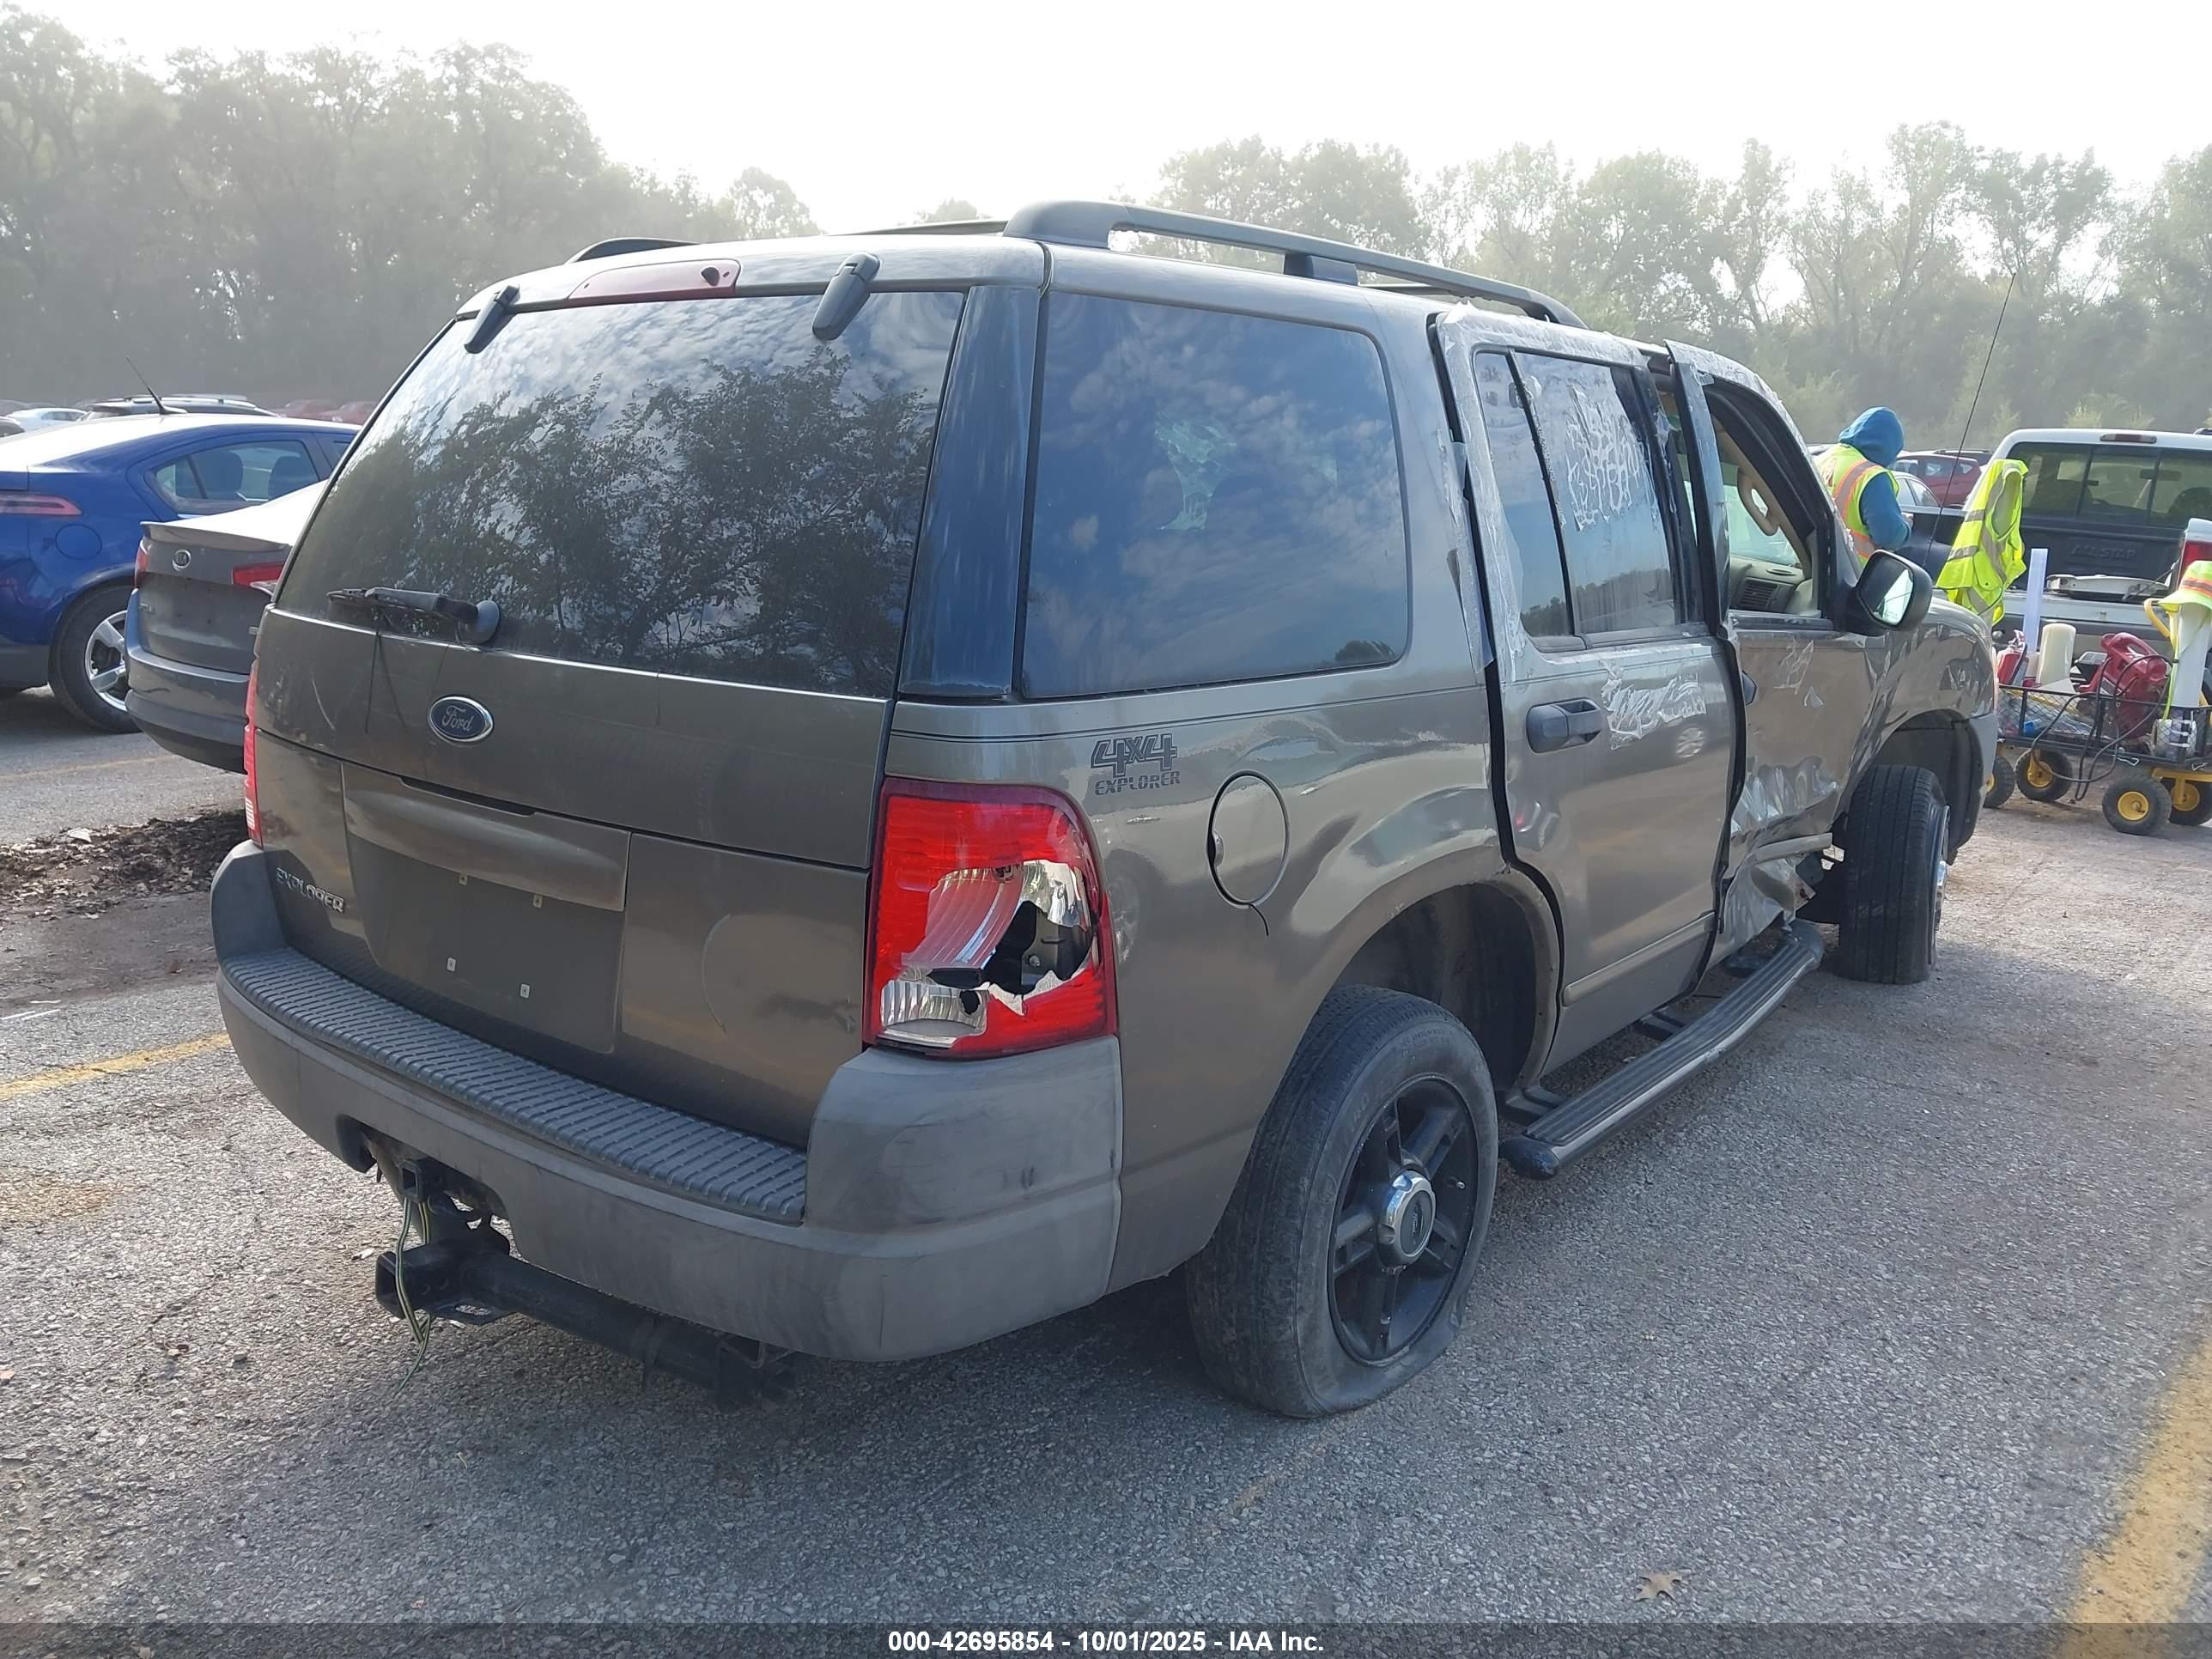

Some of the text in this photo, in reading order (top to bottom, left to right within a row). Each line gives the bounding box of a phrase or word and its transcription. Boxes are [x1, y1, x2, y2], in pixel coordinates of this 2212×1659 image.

[441, 704, 474, 732] Ford
[1095, 771, 1181, 796] EXPLORER
[276, 867, 344, 913] EXPLORER
